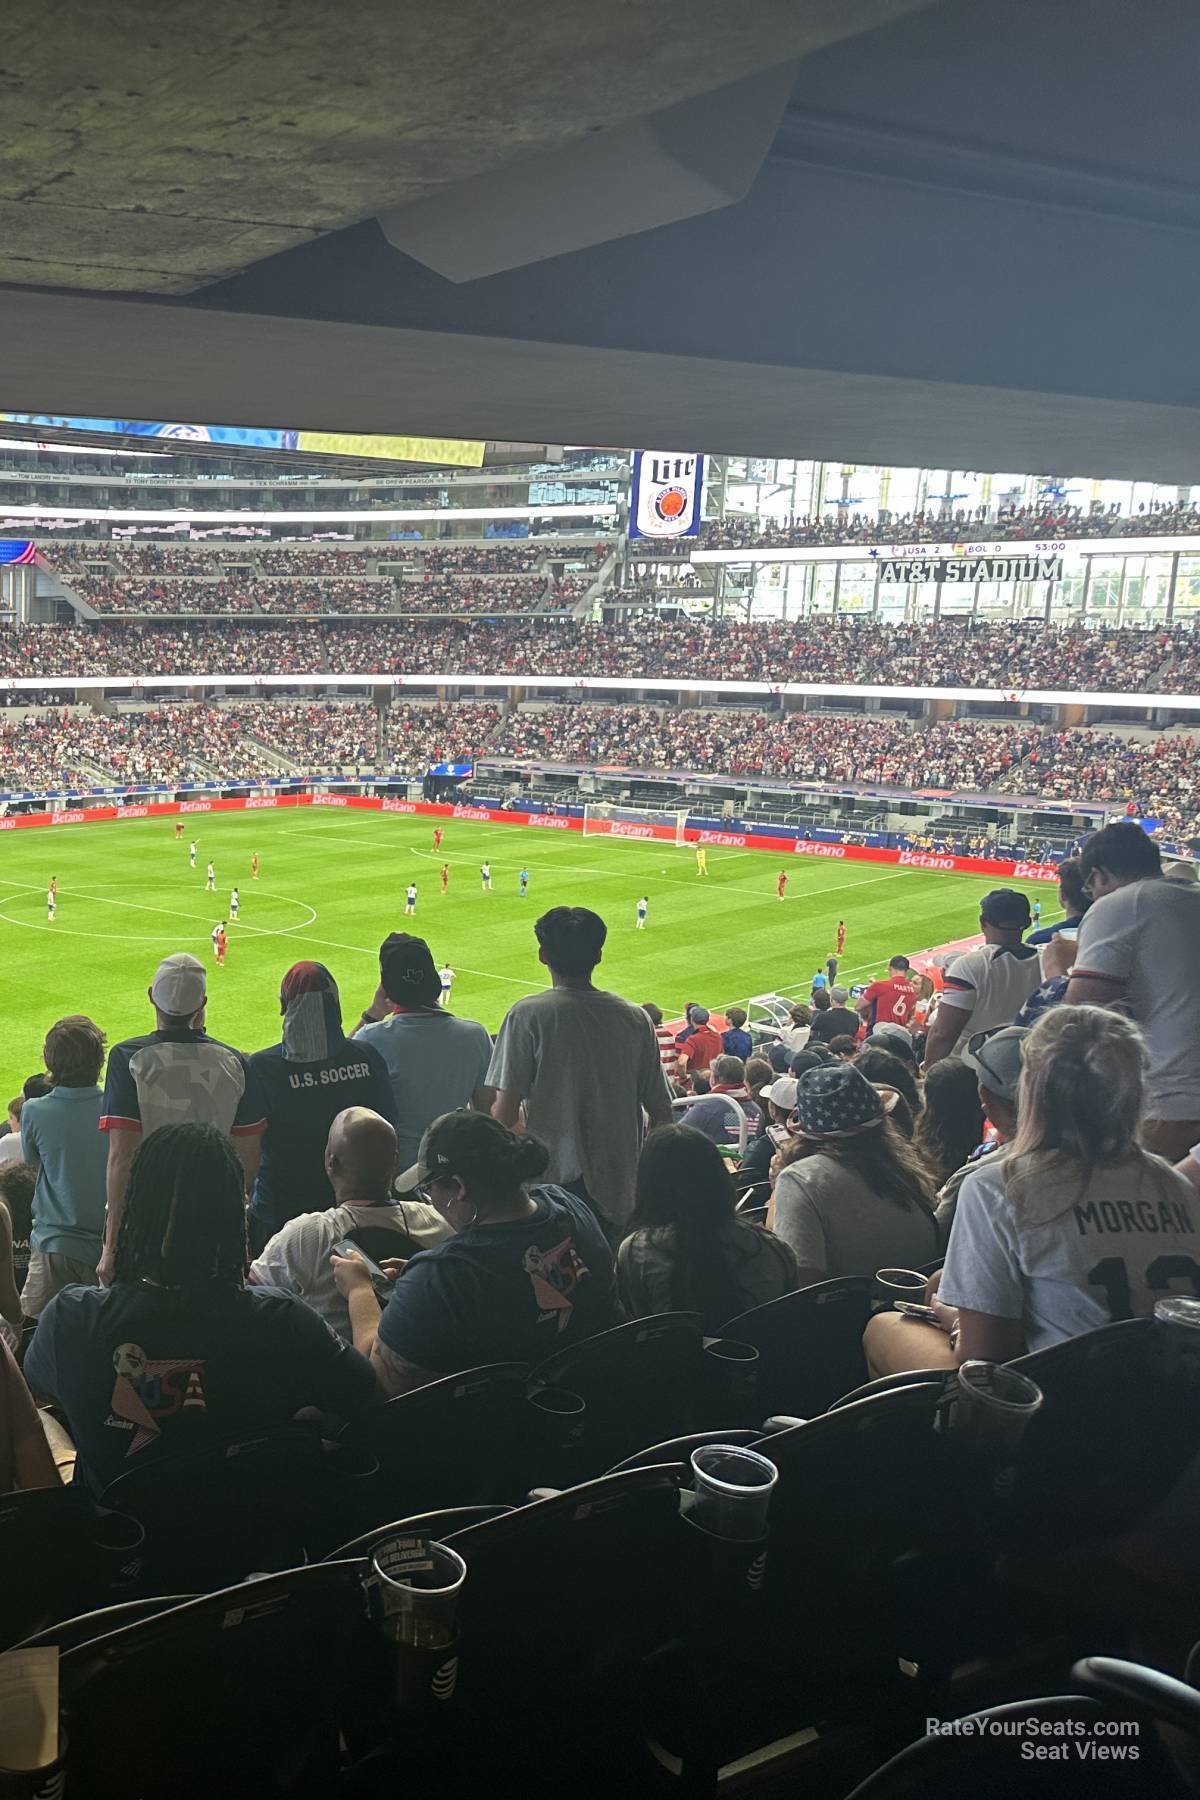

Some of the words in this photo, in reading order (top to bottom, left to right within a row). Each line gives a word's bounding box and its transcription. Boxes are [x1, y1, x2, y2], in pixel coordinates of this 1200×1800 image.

[650, 459, 694, 486] Lite
[934, 546, 941, 554] 2
[1035, 543, 1066, 551] 53:00
[880, 561, 941, 583] AT&T
[946, 559, 1059, 583] STADIUM
[179, 801, 212, 812] Betano
[245, 797, 278, 809] Betano
[312, 794, 348, 806] Betano
[381, 799, 416, 813] Betano
[51, 813, 85, 825] Betano
[117, 807, 148, 818] Betano
[453, 806, 490, 820] Betano
[528, 814, 569, 829] Betano
[610, 822, 654, 838] Betano
[699, 830, 746, 847] Betano
[794, 840, 846, 857] Betano
[898, 851, 954, 870] Betano
[893, 995, 907, 1016] 6
[289, 1072, 318, 1089] U.S.
[320, 1063, 370, 1084] SOCCER
[1072, 1200, 1195, 1235] MORGAN
